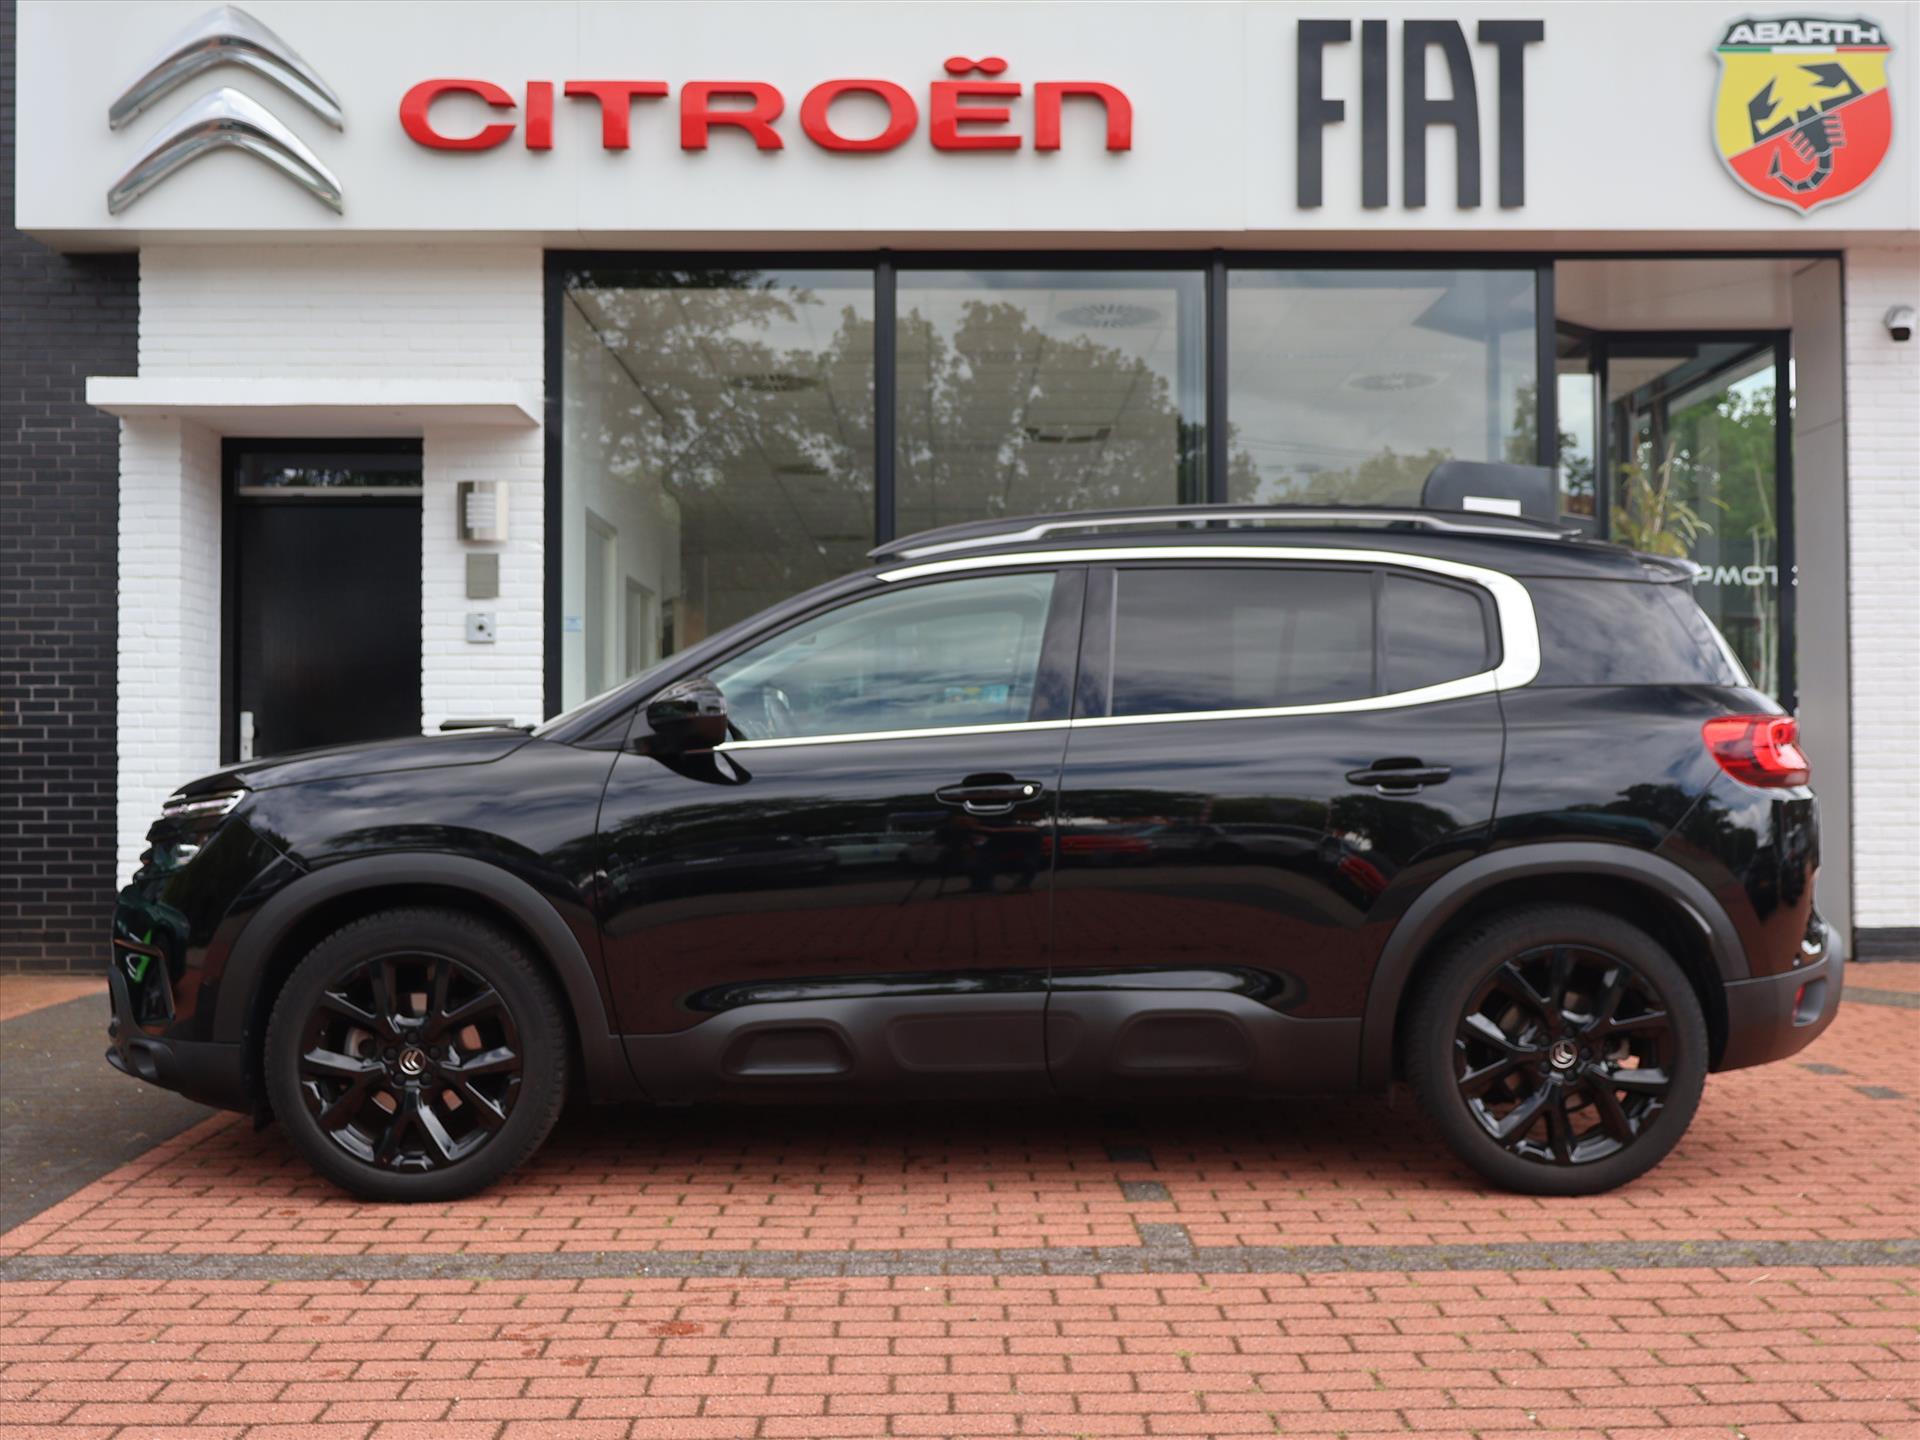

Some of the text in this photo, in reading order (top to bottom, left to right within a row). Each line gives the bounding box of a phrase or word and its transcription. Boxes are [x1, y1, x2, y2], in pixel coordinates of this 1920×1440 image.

[1727, 20, 1881, 44] ABARTH
[399, 56, 1133, 151] CITROËN
[1296, 19, 1545, 209] FIAT
